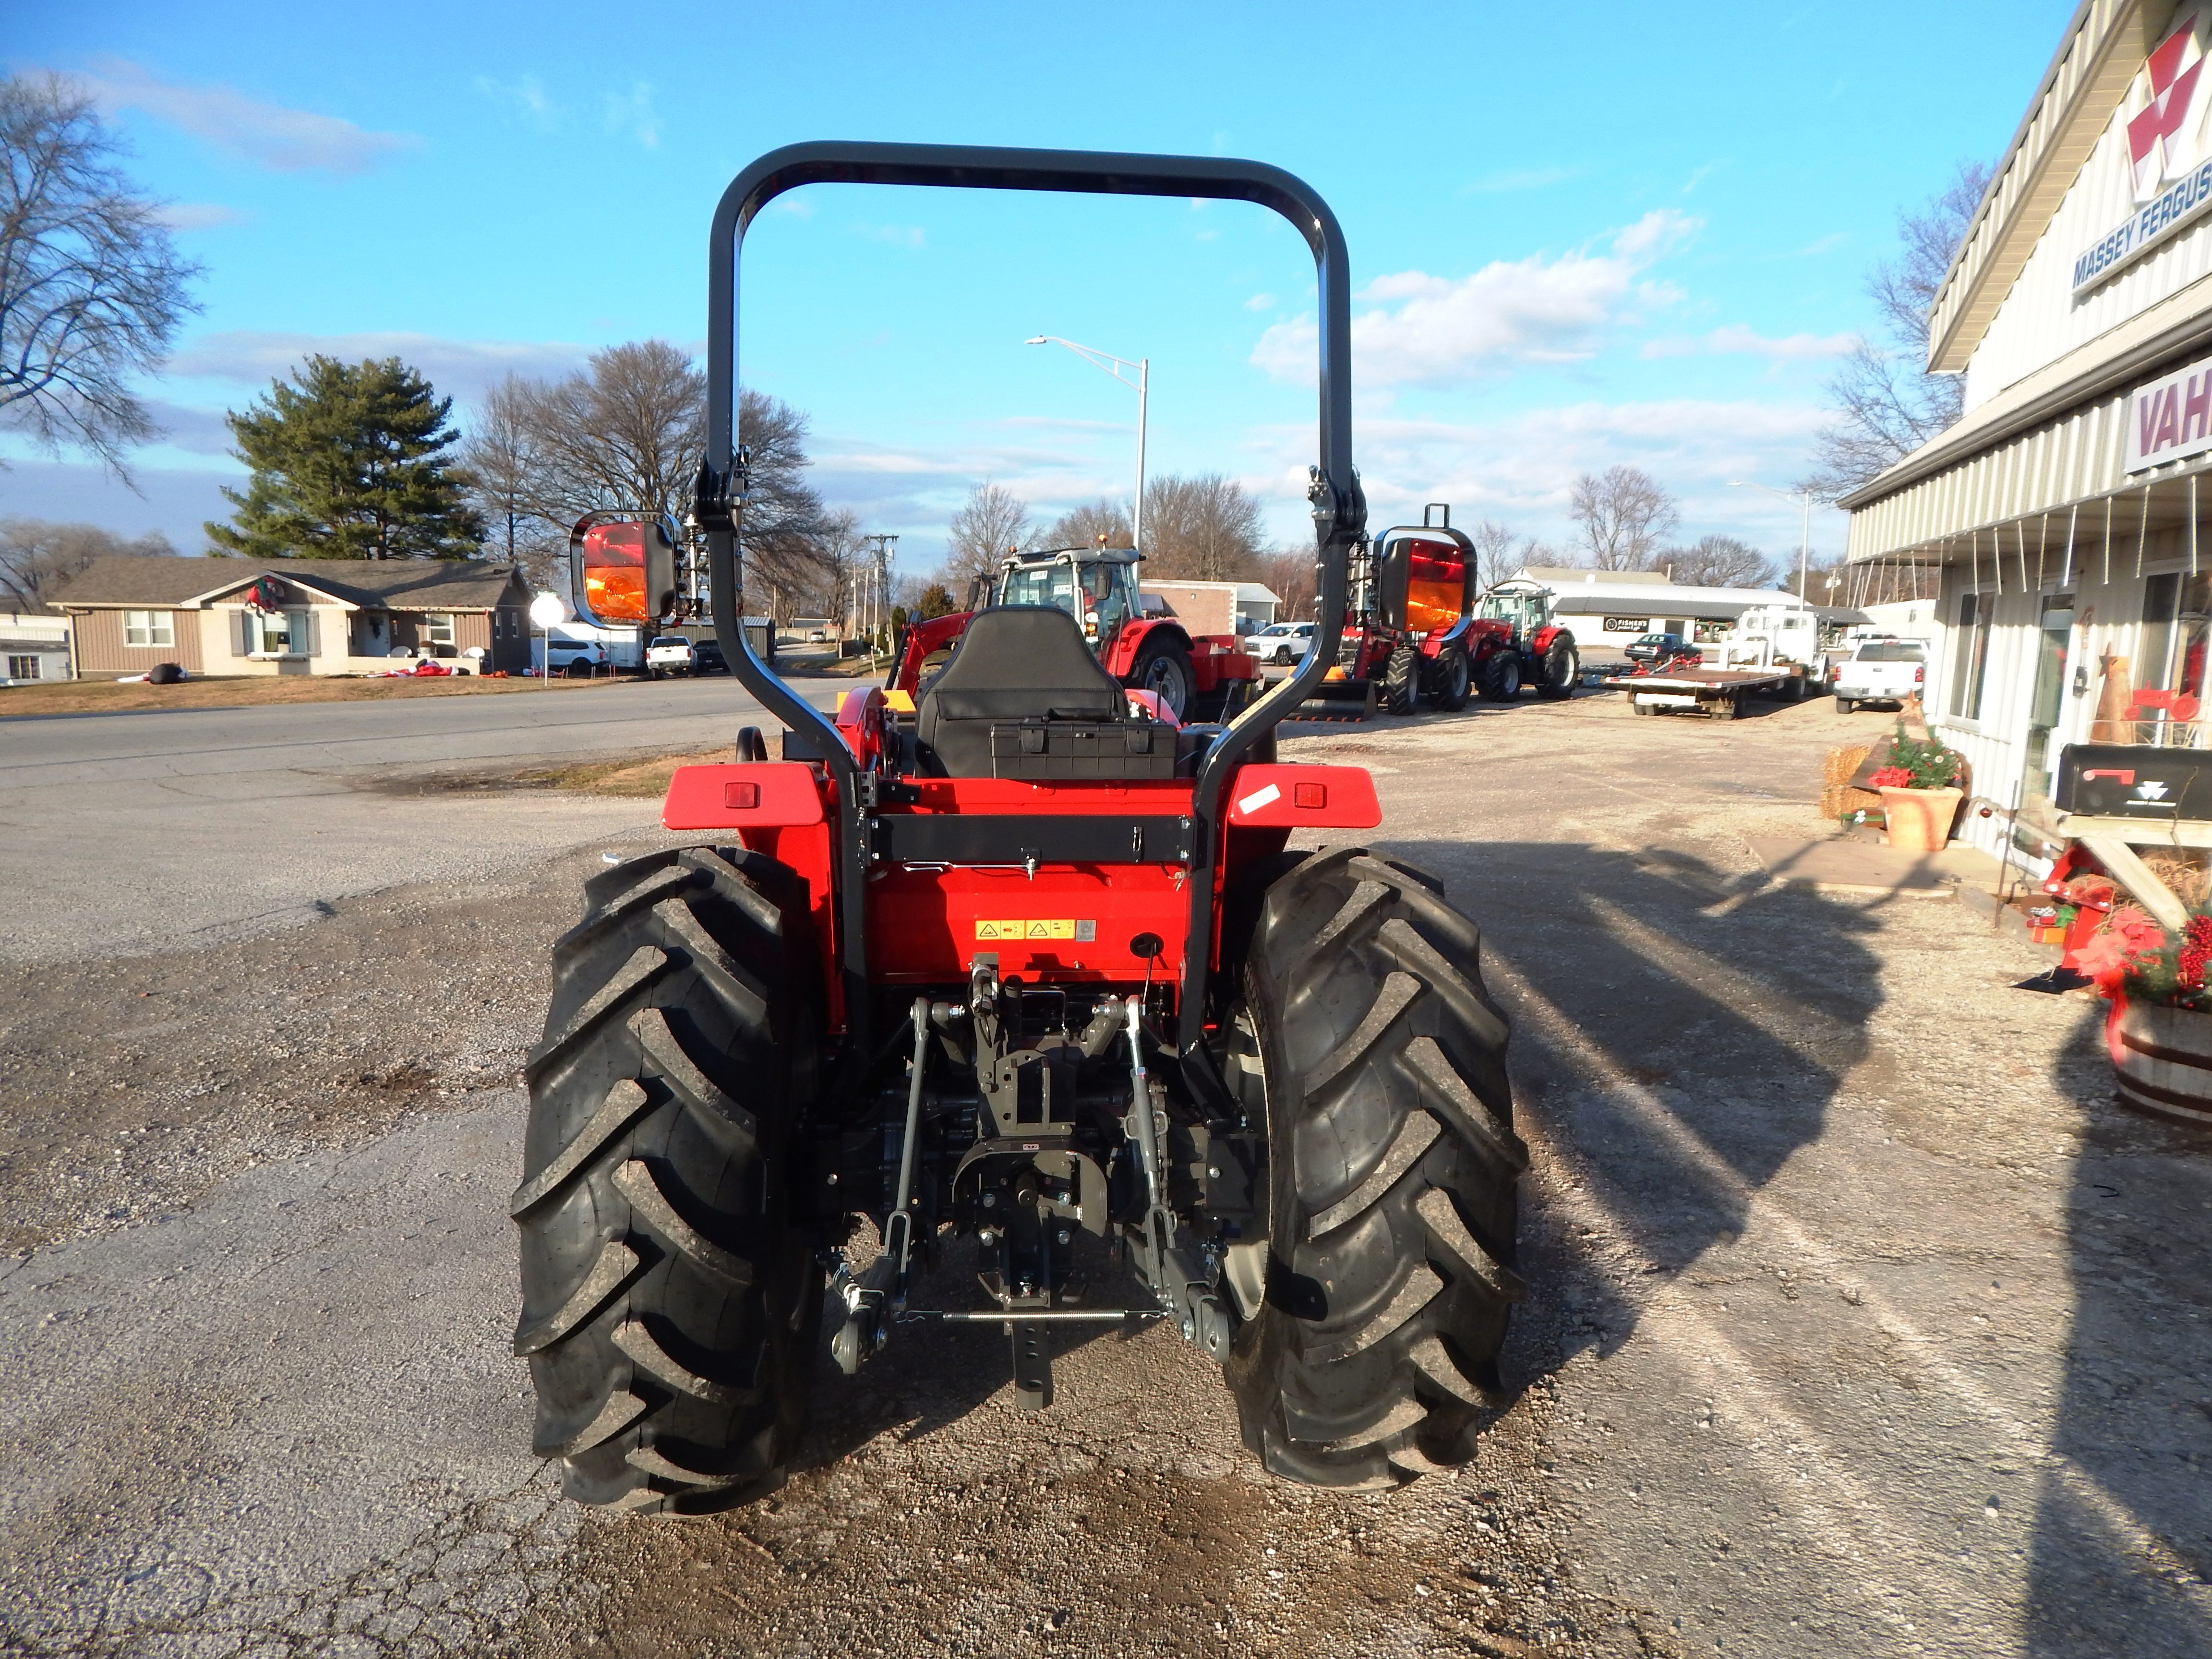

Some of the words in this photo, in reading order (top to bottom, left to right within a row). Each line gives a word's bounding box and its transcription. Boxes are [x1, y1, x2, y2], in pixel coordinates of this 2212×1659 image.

[2073, 219, 2136, 289] MASSEY
[2139, 163, 2212, 243] FERGUS
[2140, 368, 2212, 457] VAH
